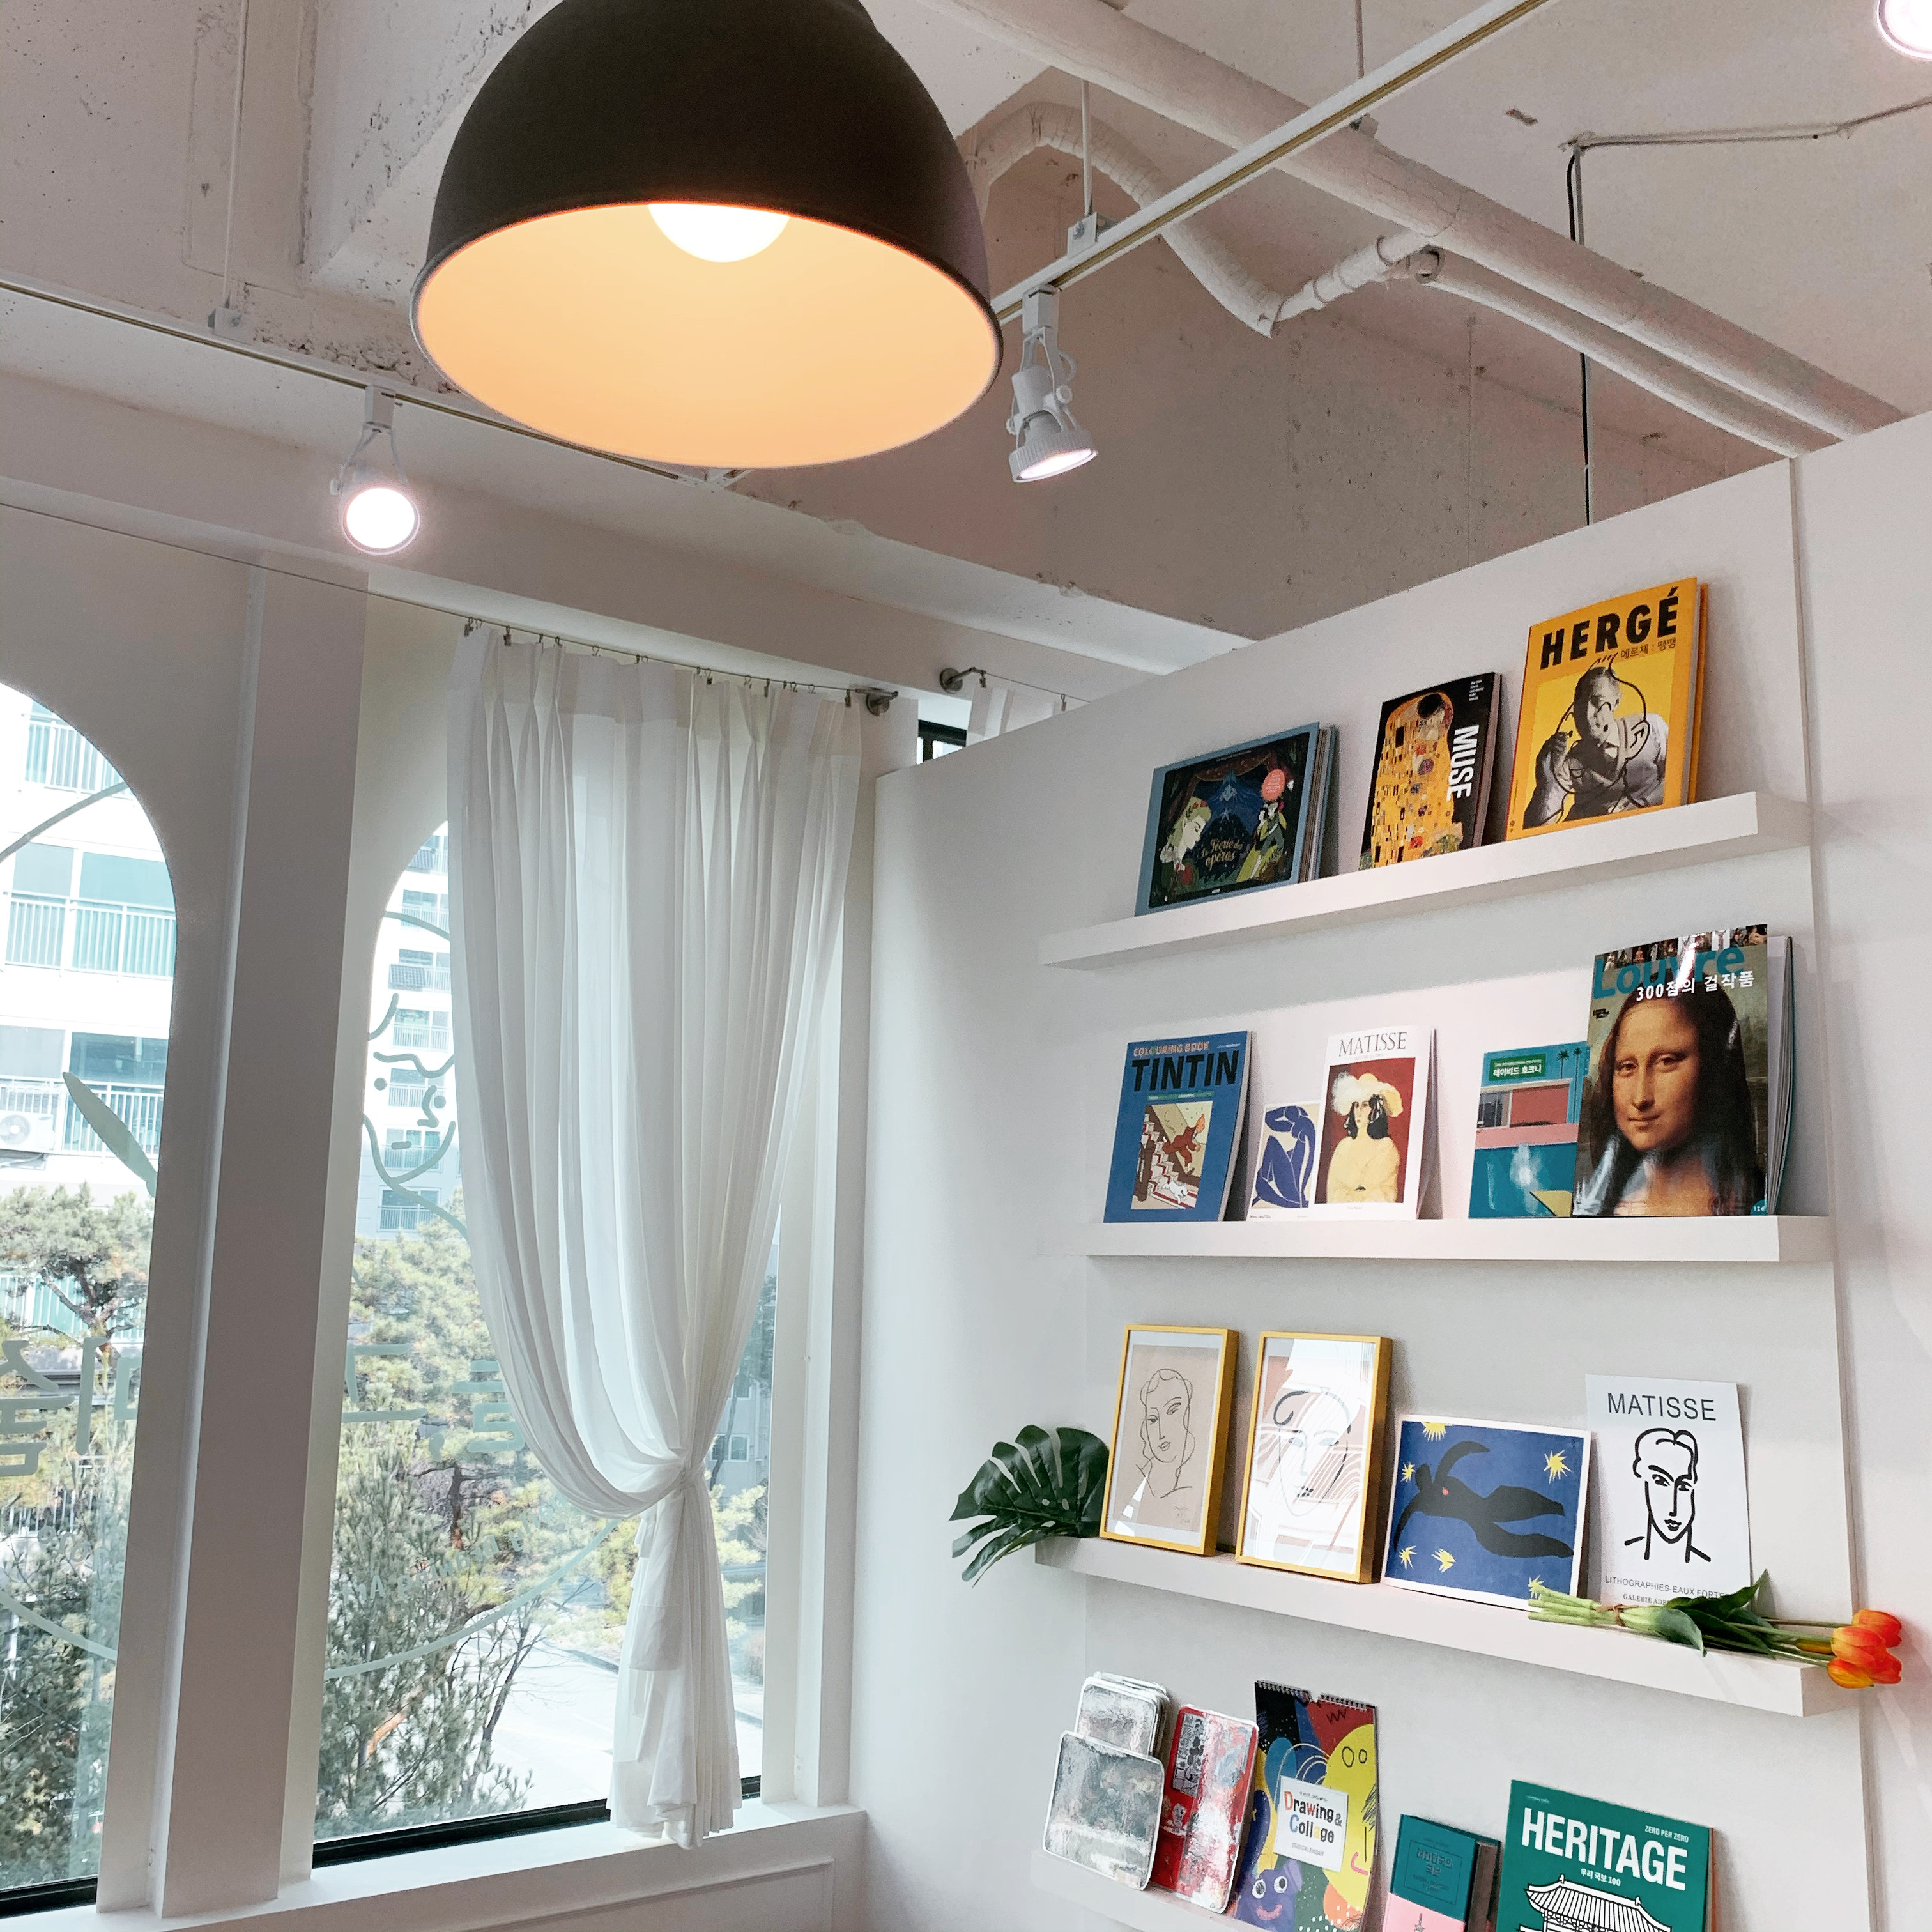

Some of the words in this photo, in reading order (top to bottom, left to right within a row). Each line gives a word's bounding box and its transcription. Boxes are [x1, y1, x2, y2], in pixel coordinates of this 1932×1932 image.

[1540, 586, 1679, 670] HERGÉ
[1446, 724, 1480, 802] MUSE
[1705, 970, 1754, 992] 걸작품
[1184, 1041, 1209, 1054] BOOK
[1338, 1032, 1407, 1057] MATISSE
[1131, 1050, 1239, 1092] TINTIN
[1493, 1066, 1519, 1077] 데이비드
[1521, 1064, 1542, 1074] 호크니
[1607, 1392, 1717, 1421] MATISSE
[1623, 1593, 1652, 1604] GALERIE
[1289, 1814, 1335, 1843] Collage
[1644, 1825, 1660, 1836] ZERO
[1661, 1829, 1673, 1838] PER
[1673, 1833, 1689, 1843] ZERO
[1521, 1807, 1688, 1891] HERITAGE
[1581, 1867, 1593, 1880] 우리
[1594, 1872, 1607, 1883] 국보
[1608, 1876, 1621, 1887] 100
